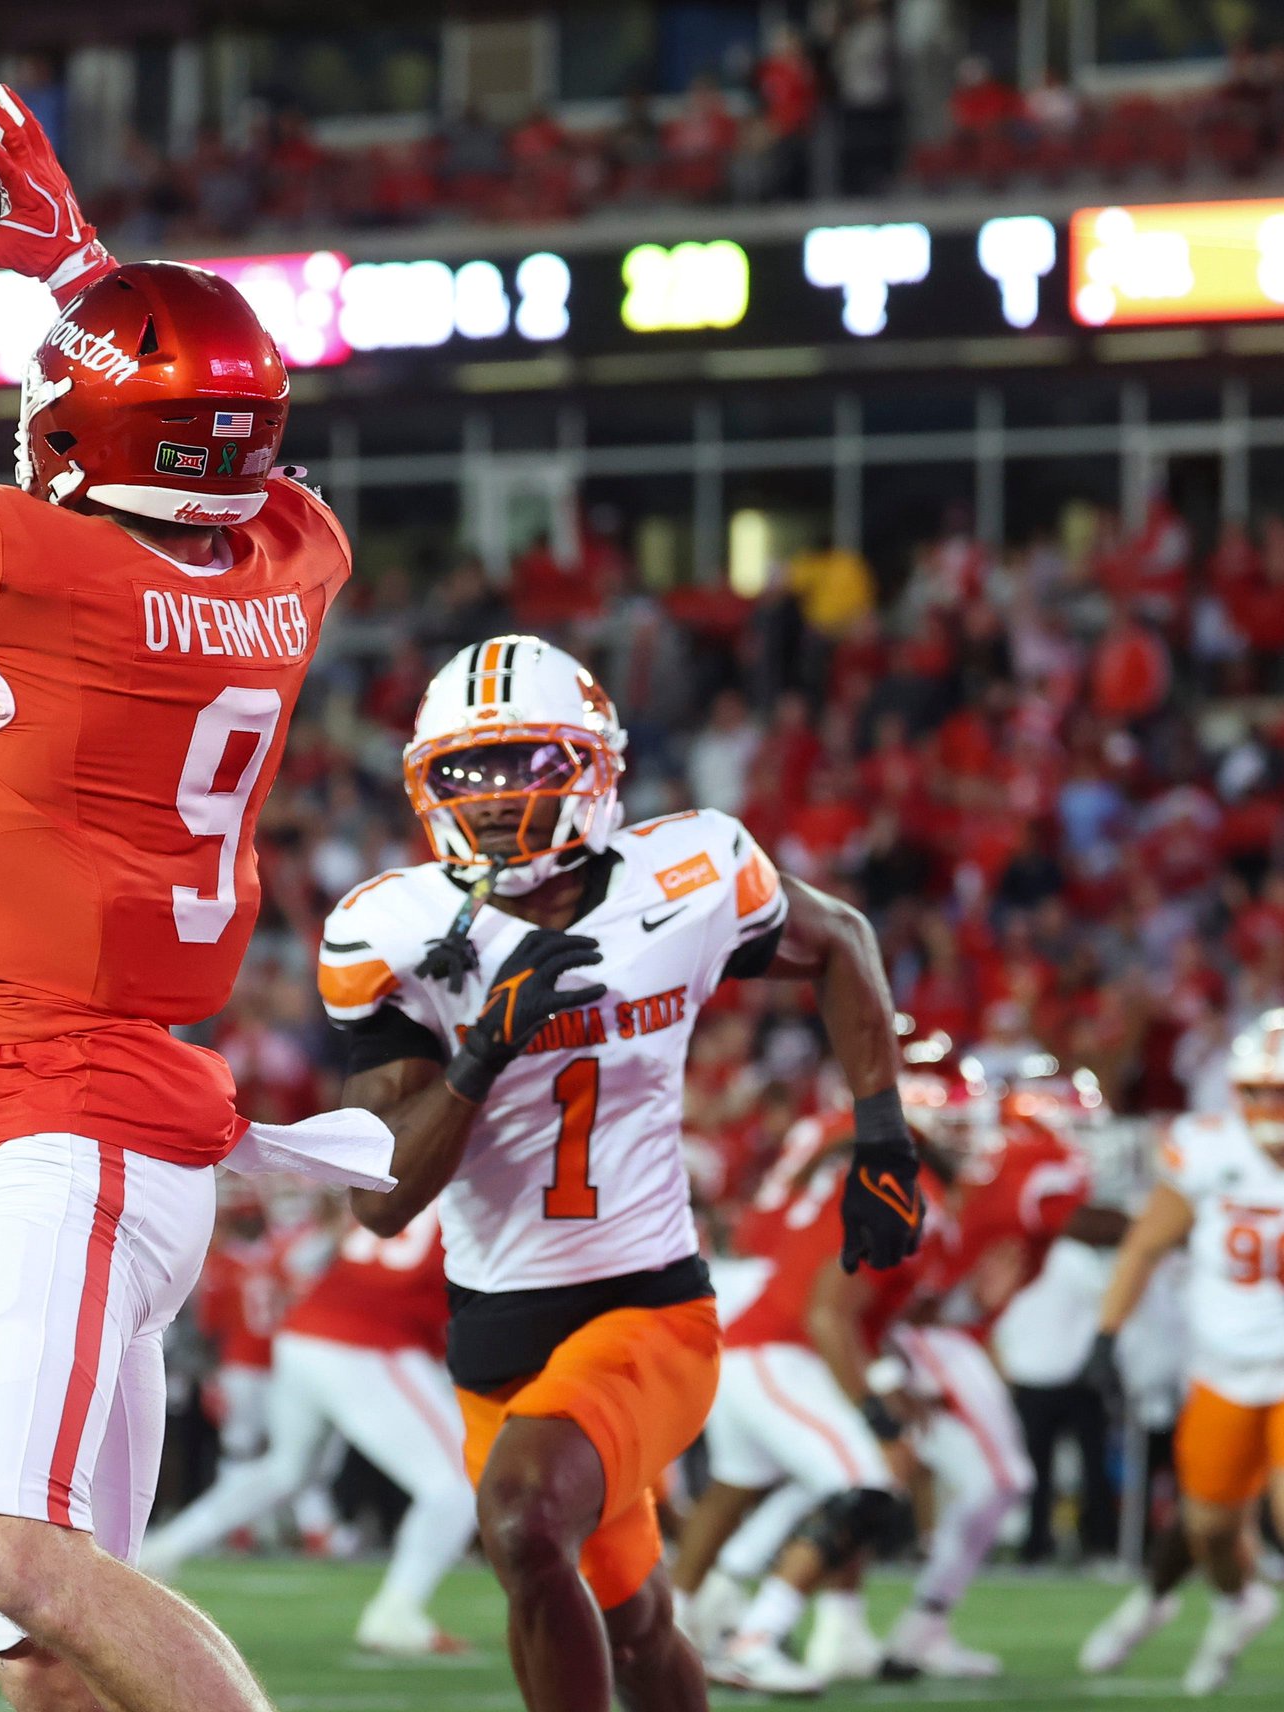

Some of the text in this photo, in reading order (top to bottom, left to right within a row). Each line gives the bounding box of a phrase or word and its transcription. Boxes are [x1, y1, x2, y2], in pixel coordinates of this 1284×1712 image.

[45, 295, 139, 386] Houston
[173, 501, 242, 523] Houston
[143, 590, 308, 658] OVERMYER
[172, 686, 281, 943] 9
[617, 985, 687, 1040] STATE
[544, 1057, 598, 1219] 1
[1224, 1224, 1284, 1292] 9
